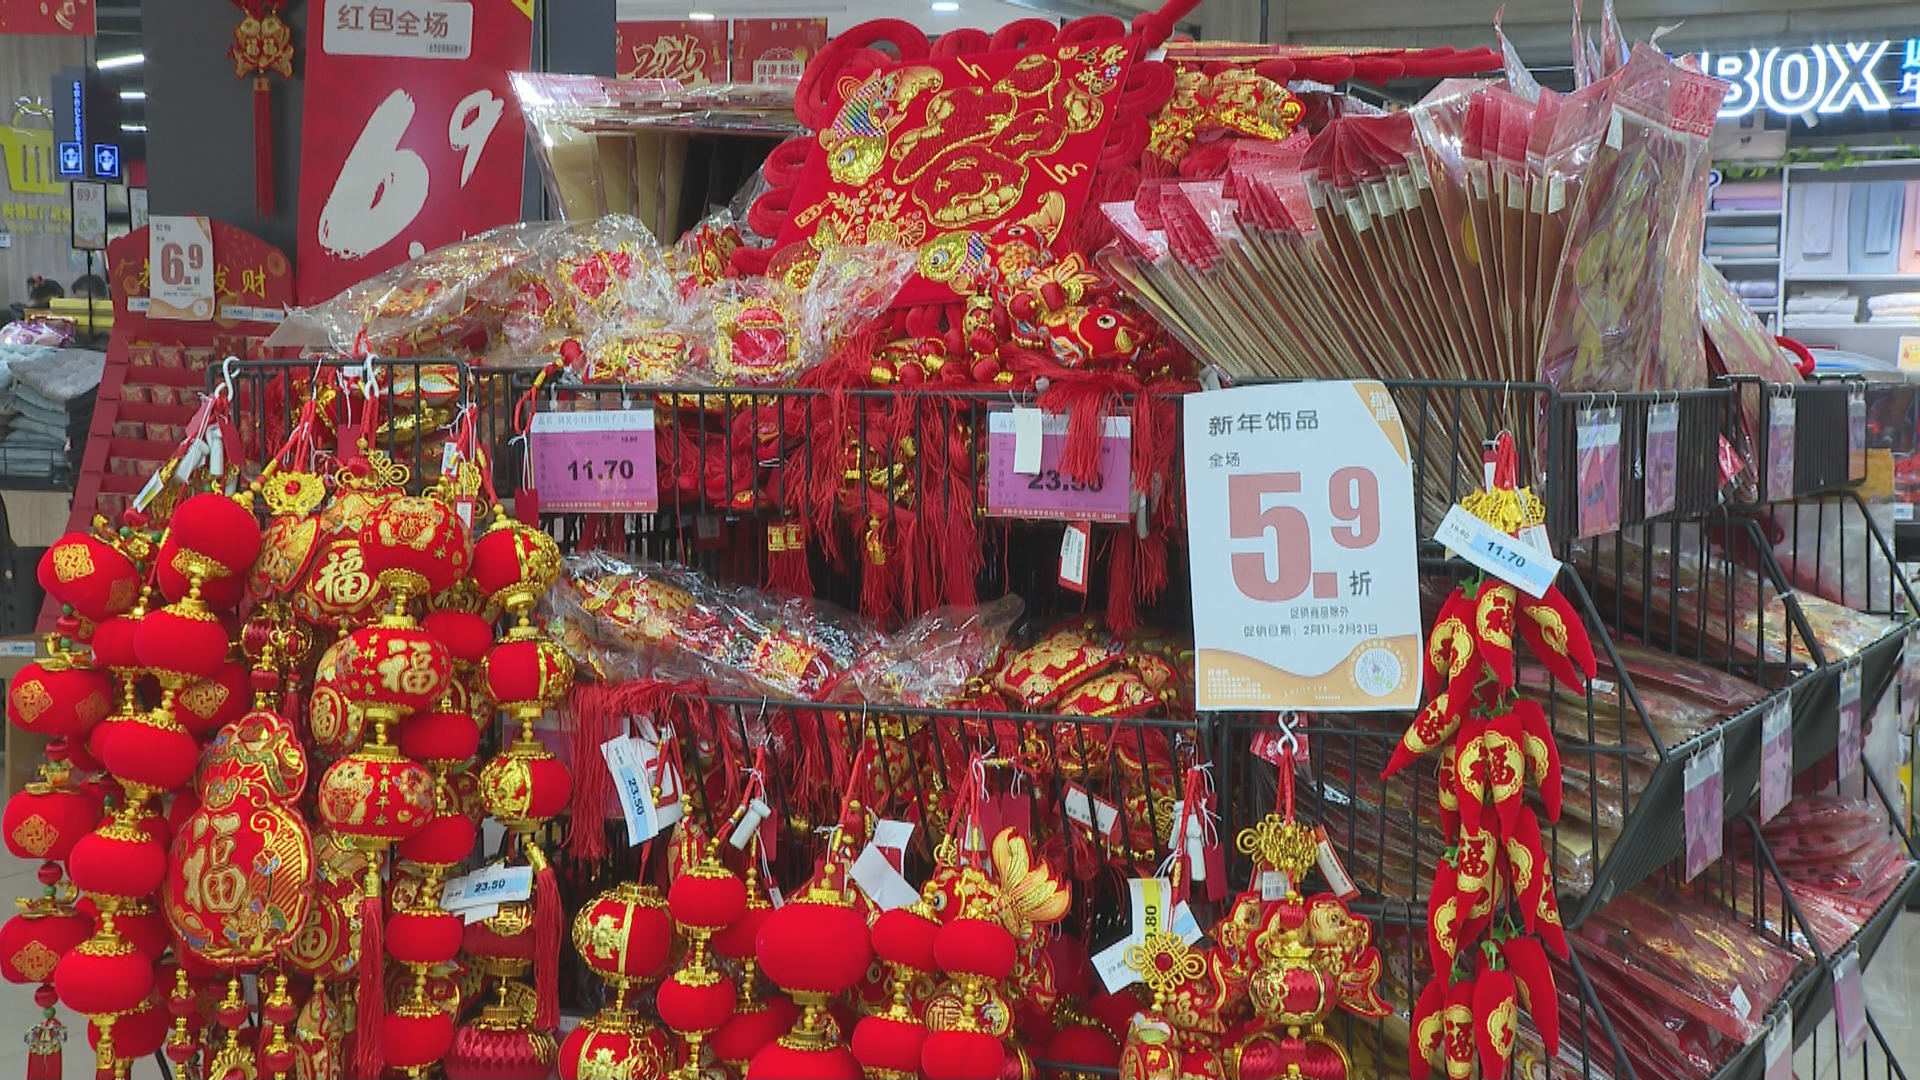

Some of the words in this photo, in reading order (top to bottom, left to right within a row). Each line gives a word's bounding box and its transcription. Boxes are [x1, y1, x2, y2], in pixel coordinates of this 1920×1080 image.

[337, 4, 449, 39] 红包全场
[1701, 40, 1892, 118] BOX
[318, 88, 504, 260] 6.9
[160, 243, 204, 286] 6.9
[1208, 410, 1319, 437] 新年饰品
[567, 459, 634, 481] 11.70
[1208, 452, 1240, 468] 全场
[1228, 466, 1381, 602] 5.9
[1487, 541, 1526, 568] 11.70
[314, 547, 370, 604] 福
[1349, 570, 1372, 597] 折
[1290, 606, 1349, 619] 促销商品除外
[377, 638, 438, 693] 福
[627, 778, 645, 815] 23.50
[182, 812, 248, 913] 福
[474, 879, 506, 893] 23.50
